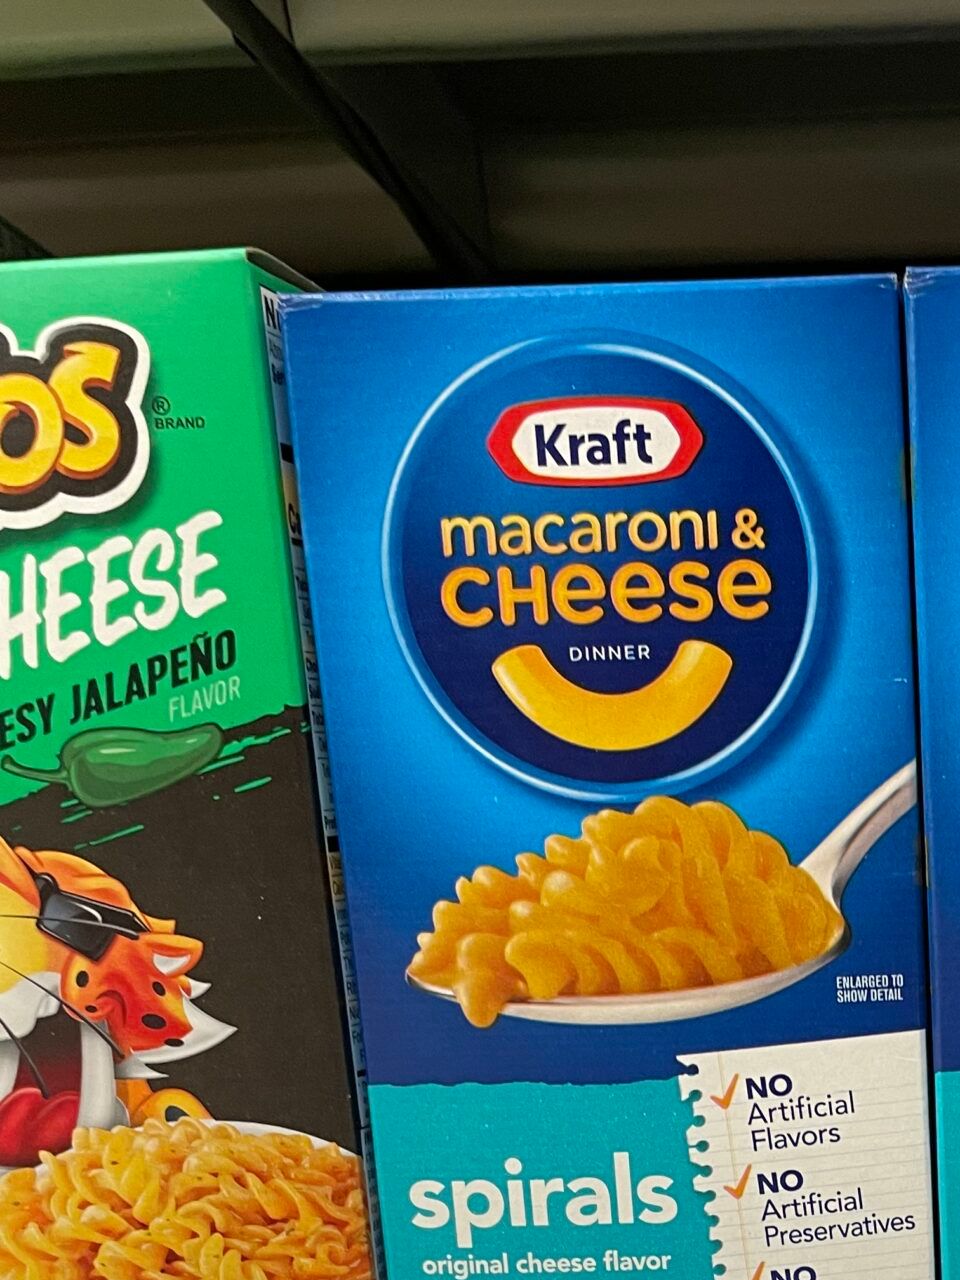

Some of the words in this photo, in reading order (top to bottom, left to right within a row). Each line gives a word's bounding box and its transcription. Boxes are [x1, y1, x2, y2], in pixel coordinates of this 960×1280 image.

[154, 415, 205, 429] BRAND
[534, 419, 652, 466] Kraft
[441, 510, 718, 558] macaroni
[731, 508, 765, 549] &
[569, 645, 650, 661] DINNER
[70, 629, 236, 725] JALAPEÑO
[168, 677, 240, 722] FLAVOR
[836, 975, 888, 989] ENLARGED
[891, 974, 903, 987] TO
[837, 989, 867, 1003] SHOW
[871, 988, 903, 1001] DETAIL
[745, 1074, 793, 1099] NO
[747, 1091, 856, 1124] Artificial
[751, 1124, 841, 1152] Flavors
[757, 1170, 804, 1194] NO
[409, 1152, 678, 1248] spirals
[761, 1188, 864, 1221] Artificial
[764, 1212, 916, 1247] Preservatives
[422, 1252, 508, 1280] original
[516, 1252, 596, 1274] cheese
[603, 1250, 671, 1271] flavor
